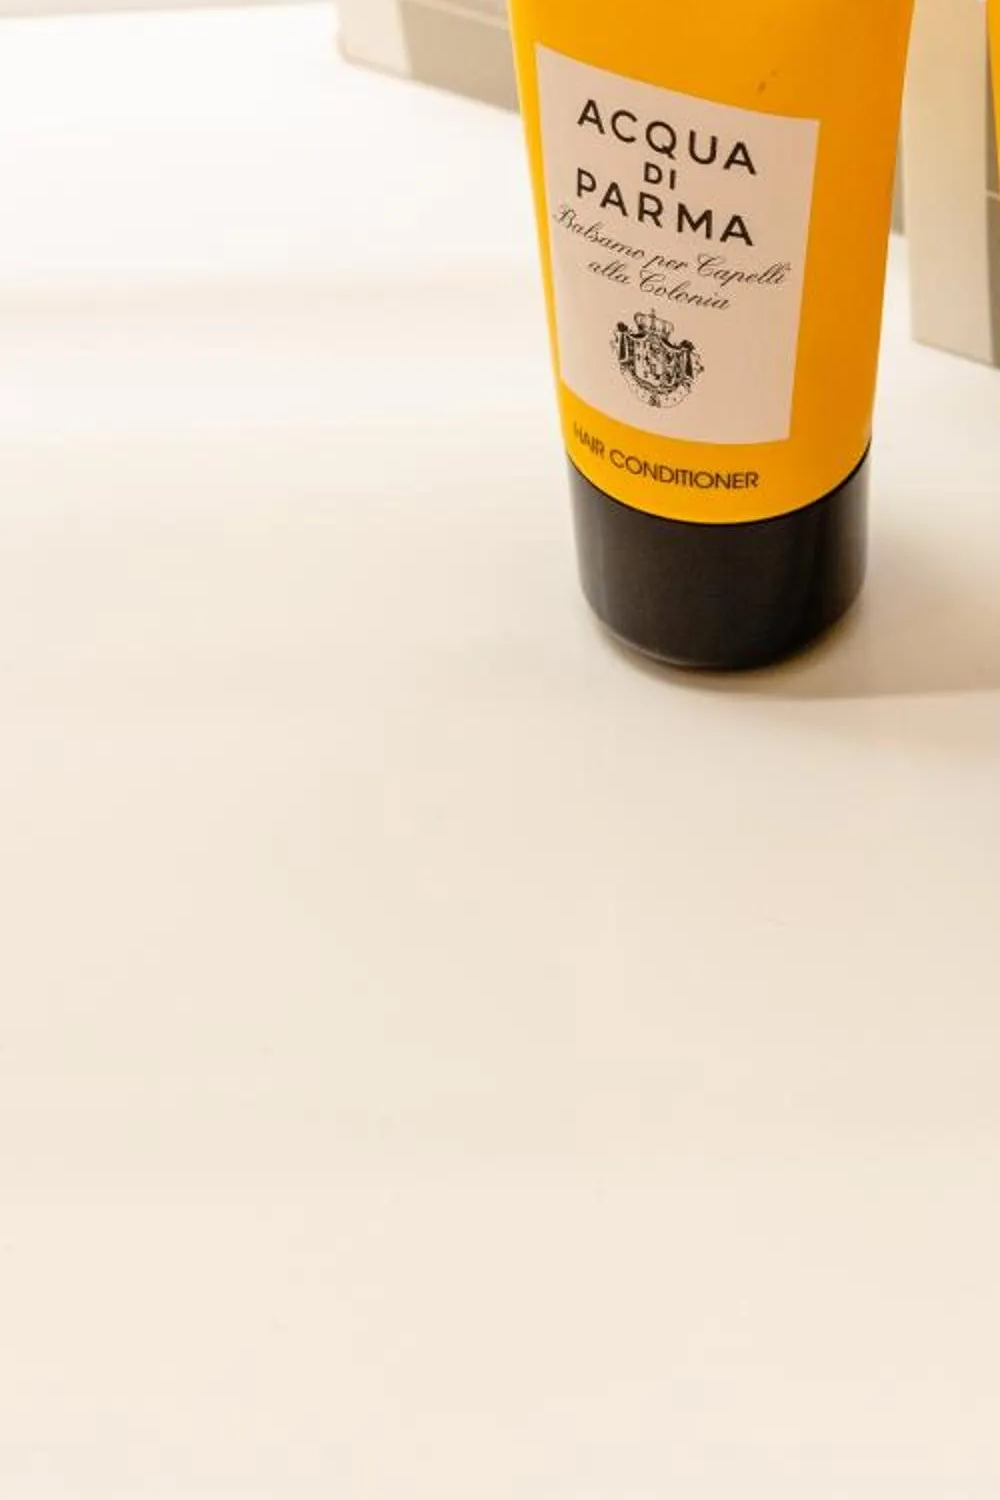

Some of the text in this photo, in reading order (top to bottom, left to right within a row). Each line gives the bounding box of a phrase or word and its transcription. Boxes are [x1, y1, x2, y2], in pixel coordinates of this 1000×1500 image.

[577, 99, 757, 176] ACQUA
[577, 167, 754, 247] PARMA
[644, 161, 676, 190] DI
[553, 202, 792, 288] Balsamo per Capelli
[587, 258, 731, 311] alla Colonia
[573, 419, 760, 489] HAIR CONDITIONER
